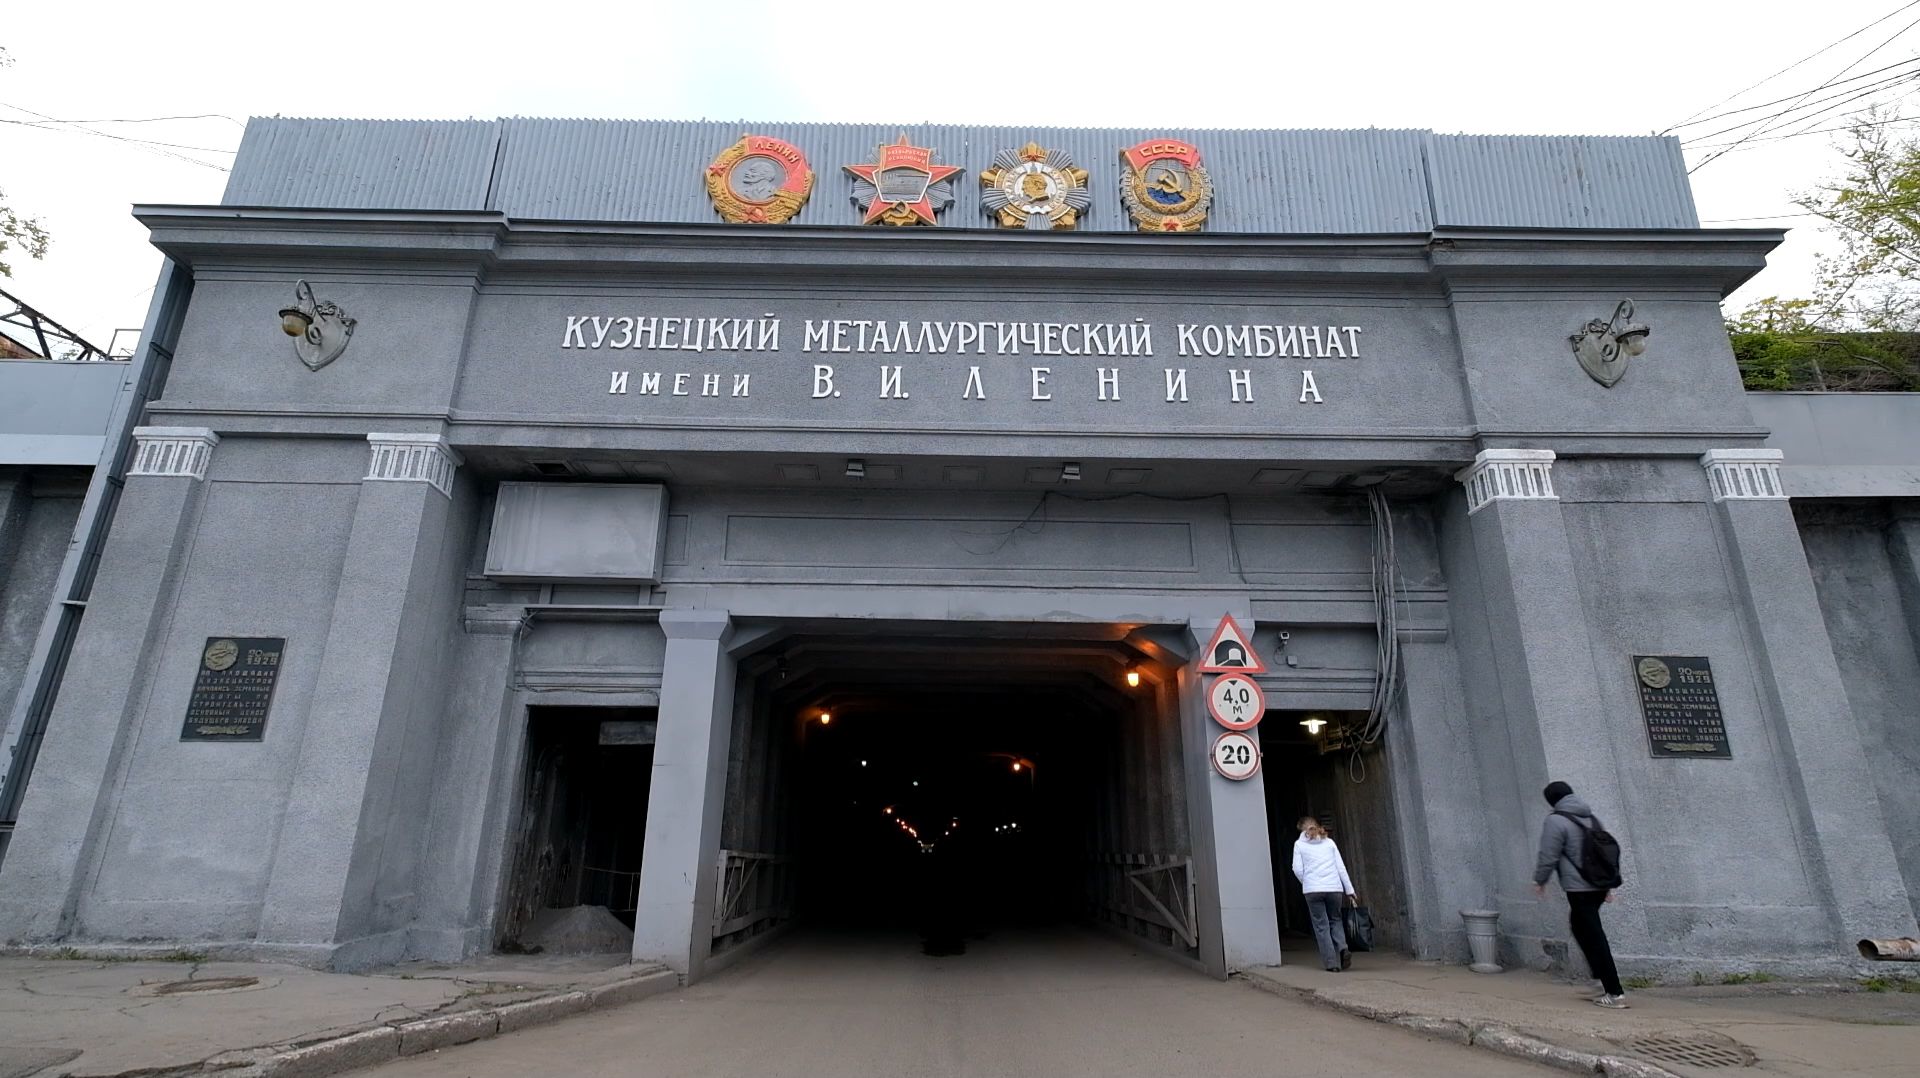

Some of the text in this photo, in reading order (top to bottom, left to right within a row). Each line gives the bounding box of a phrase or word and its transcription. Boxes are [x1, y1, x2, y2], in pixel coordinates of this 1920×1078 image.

[755, 140, 800, 164] ЛЕНИН
[1139, 143, 1188, 157] СССР
[562, 313, 1362, 358] КУЗНЕЦКИЙ МЕТАЛЛУРГИЧЕСКИЙ КОМБИНАТ
[609, 371, 750, 397] ИМЕНИ
[963, 367, 1323, 403] ЛЕНИНА
[248, 657, 278, 665] 1929
[1678, 667, 1692, 675] 20
[1679, 675, 1711, 683] 1929
[1223, 688, 1250, 705] 4,0
[1221, 745, 1250, 765] 20
